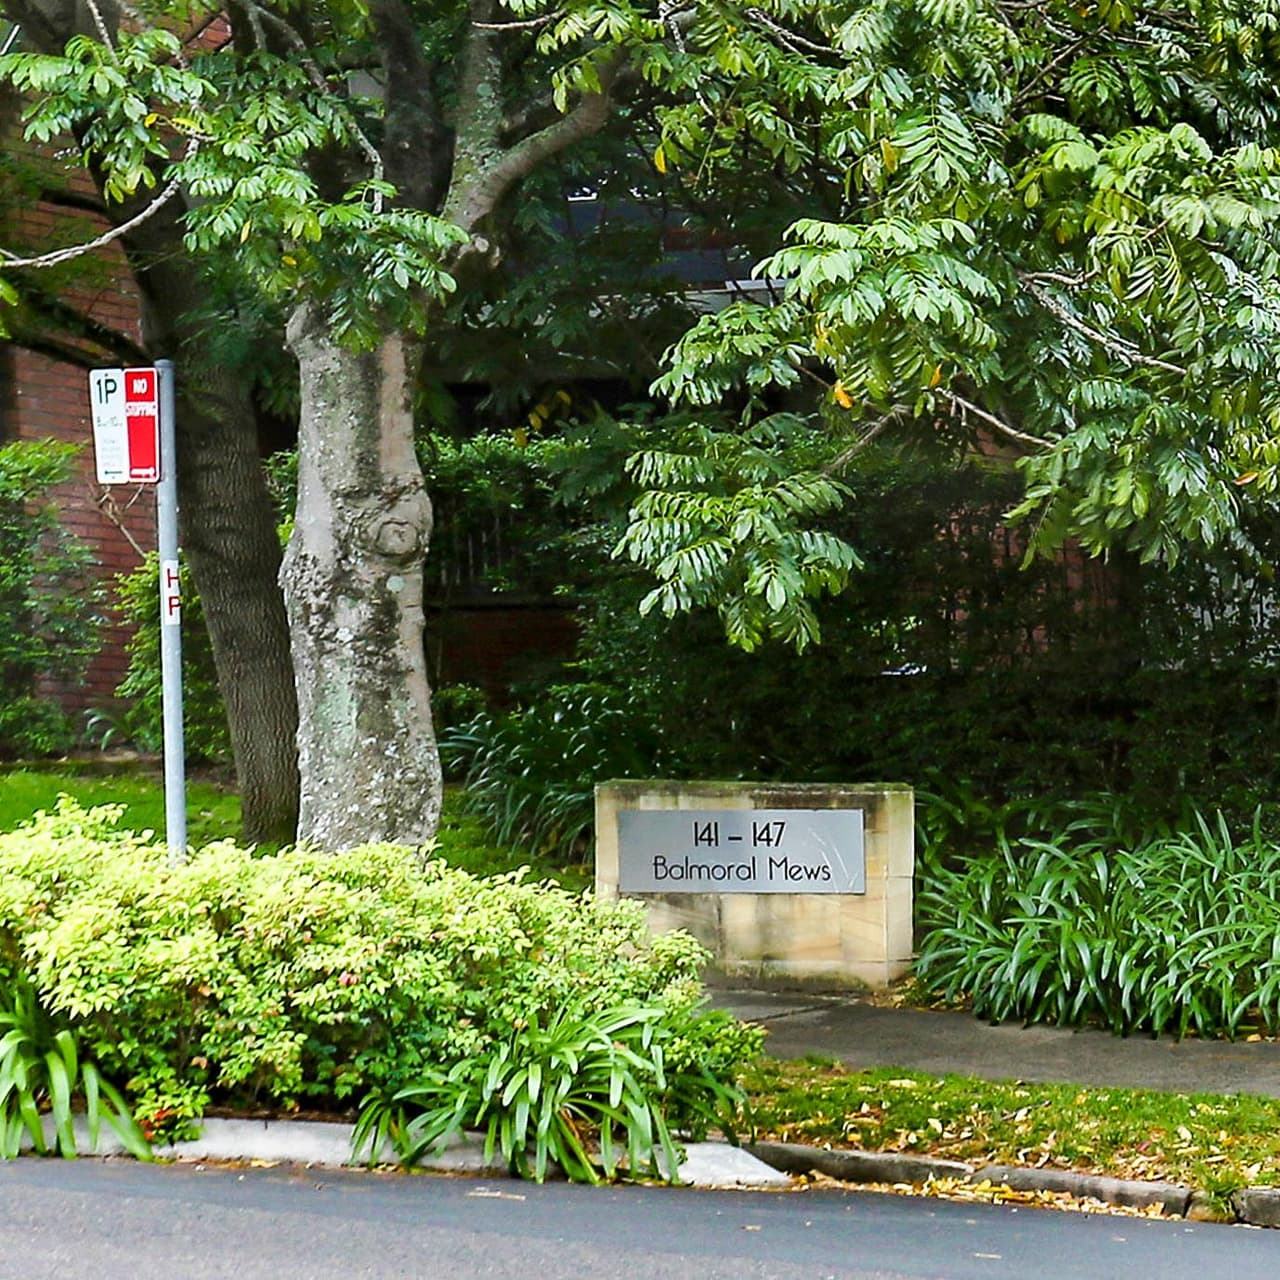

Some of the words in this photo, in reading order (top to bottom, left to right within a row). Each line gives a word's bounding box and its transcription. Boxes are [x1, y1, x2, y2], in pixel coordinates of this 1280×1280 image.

[96, 377, 118, 405] 1P
[132, 377, 149, 395] NO
[693, 821, 719, 847] 141
[752, 821, 786, 847] 147
[652, 854, 757, 881] Balmoral
[768, 855, 832, 882] Mews
